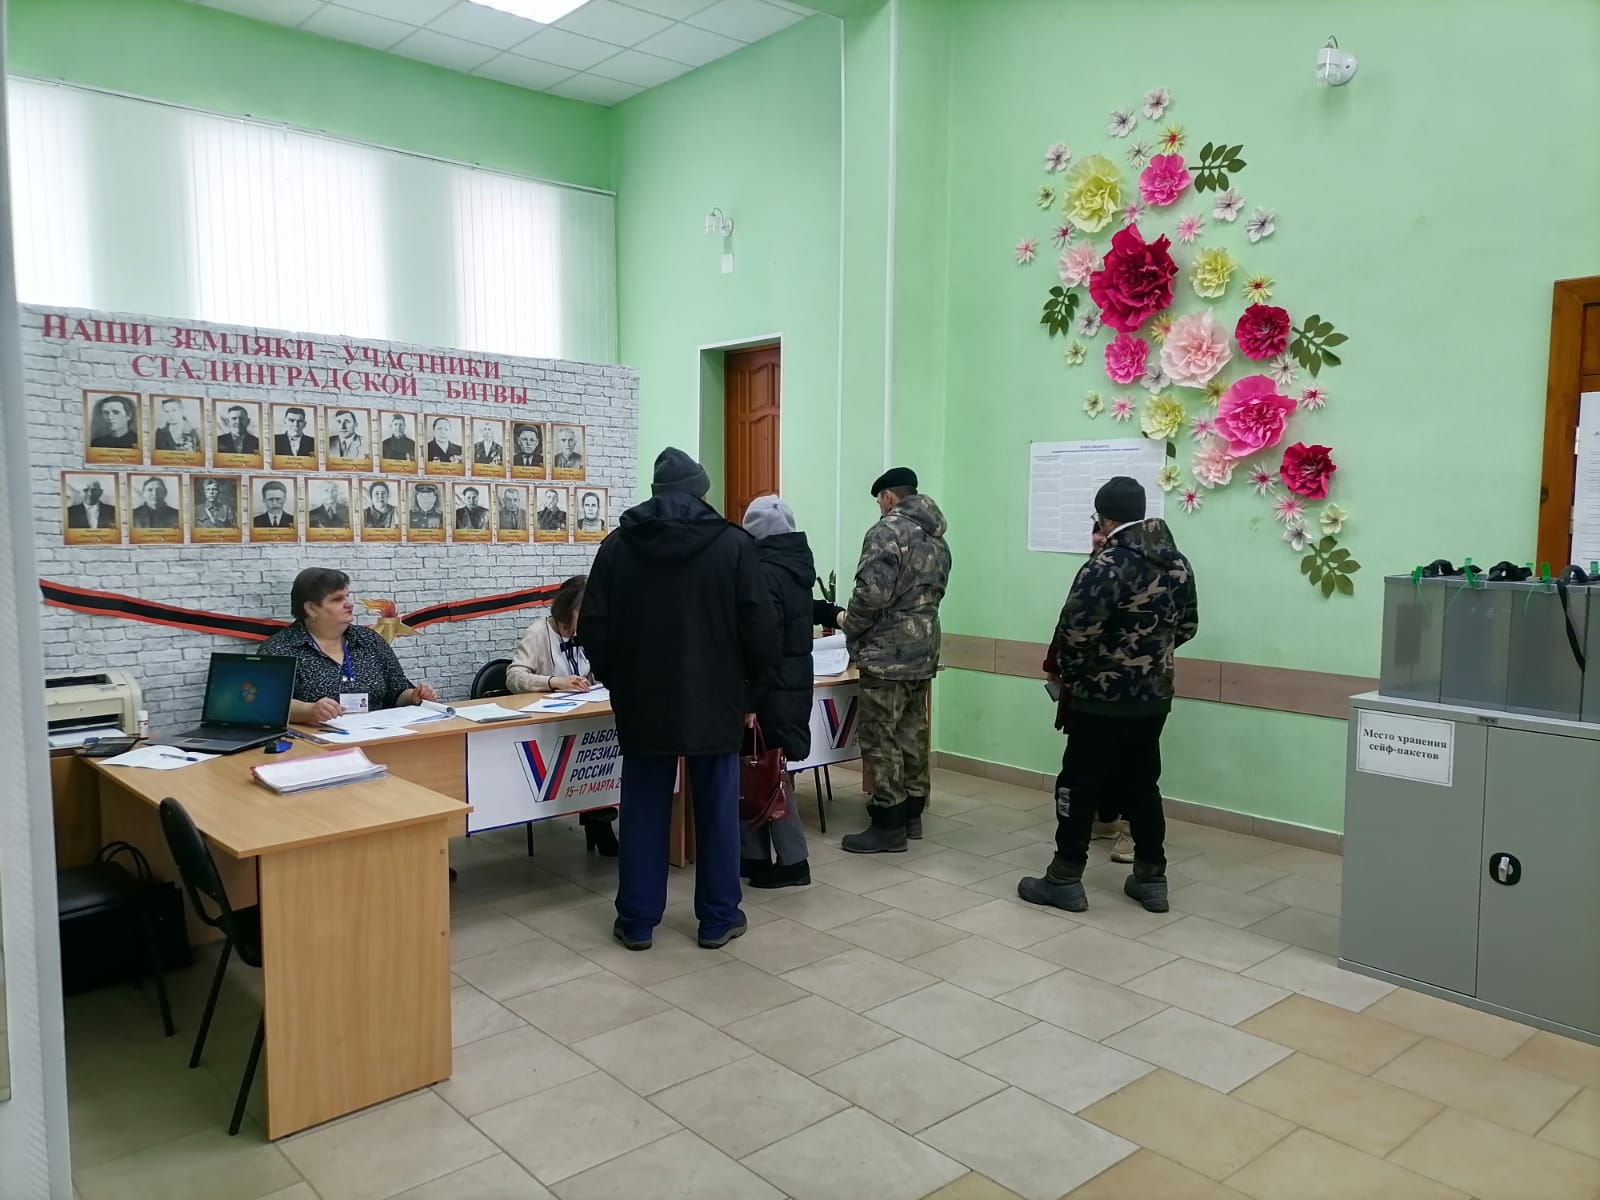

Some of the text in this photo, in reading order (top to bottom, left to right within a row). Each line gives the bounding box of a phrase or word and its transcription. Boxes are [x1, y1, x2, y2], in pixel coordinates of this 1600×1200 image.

[42, 313, 151, 346] НАШИ
[167, 326, 314, 361] ЗЕМЛЯКИ
[342, 345, 501, 380] УЧАСТНИКИ
[131, 354, 528, 405] СТАЛИНГРАДСКОЙ БИТВЫ
[581, 728, 619, 746] ВЫБОР
[1363, 728, 1447, 749] Место хранения
[1369, 742, 1441, 760] сейф-пакетов
[570, 762, 615, 782] РОССИИ
[588, 777, 615, 794] МАРТА
